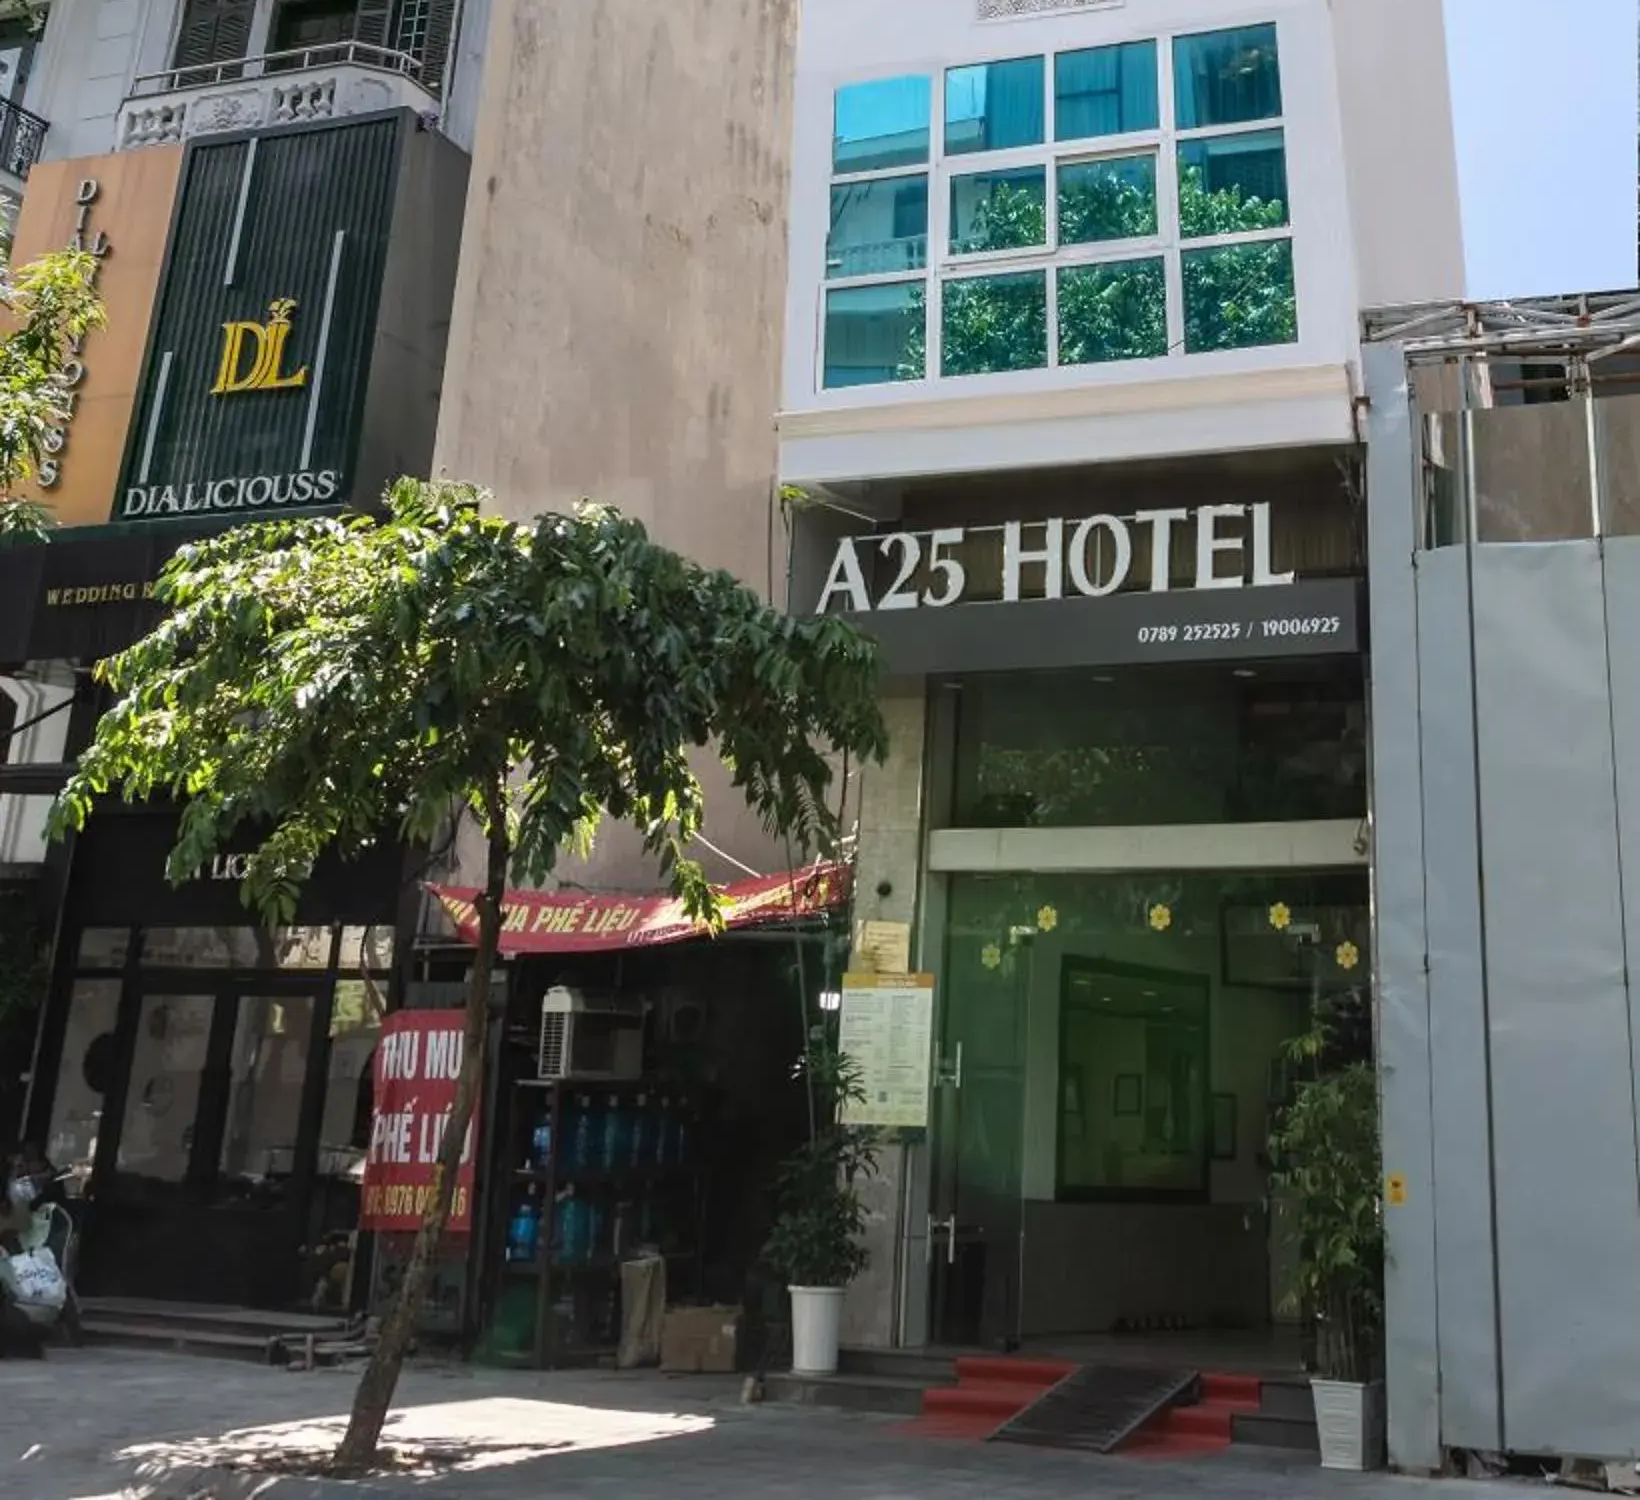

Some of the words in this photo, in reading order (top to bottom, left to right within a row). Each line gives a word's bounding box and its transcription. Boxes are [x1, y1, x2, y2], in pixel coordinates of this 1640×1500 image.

[122, 469, 336, 517] DIALICIOUSS
[815, 527, 967, 615] A25
[1002, 501, 1296, 602] HOTEL
[46, 582, 136, 605] WEDDING
[1137, 624, 1178, 644] 0789
[1183, 622, 1241, 642] 252525
[1261, 616, 1341, 638] 19006925
[580, 903, 641, 938] LIỆU
[381, 1029, 420, 1082] THU
[366, 1095, 418, 1164] PHẾ
